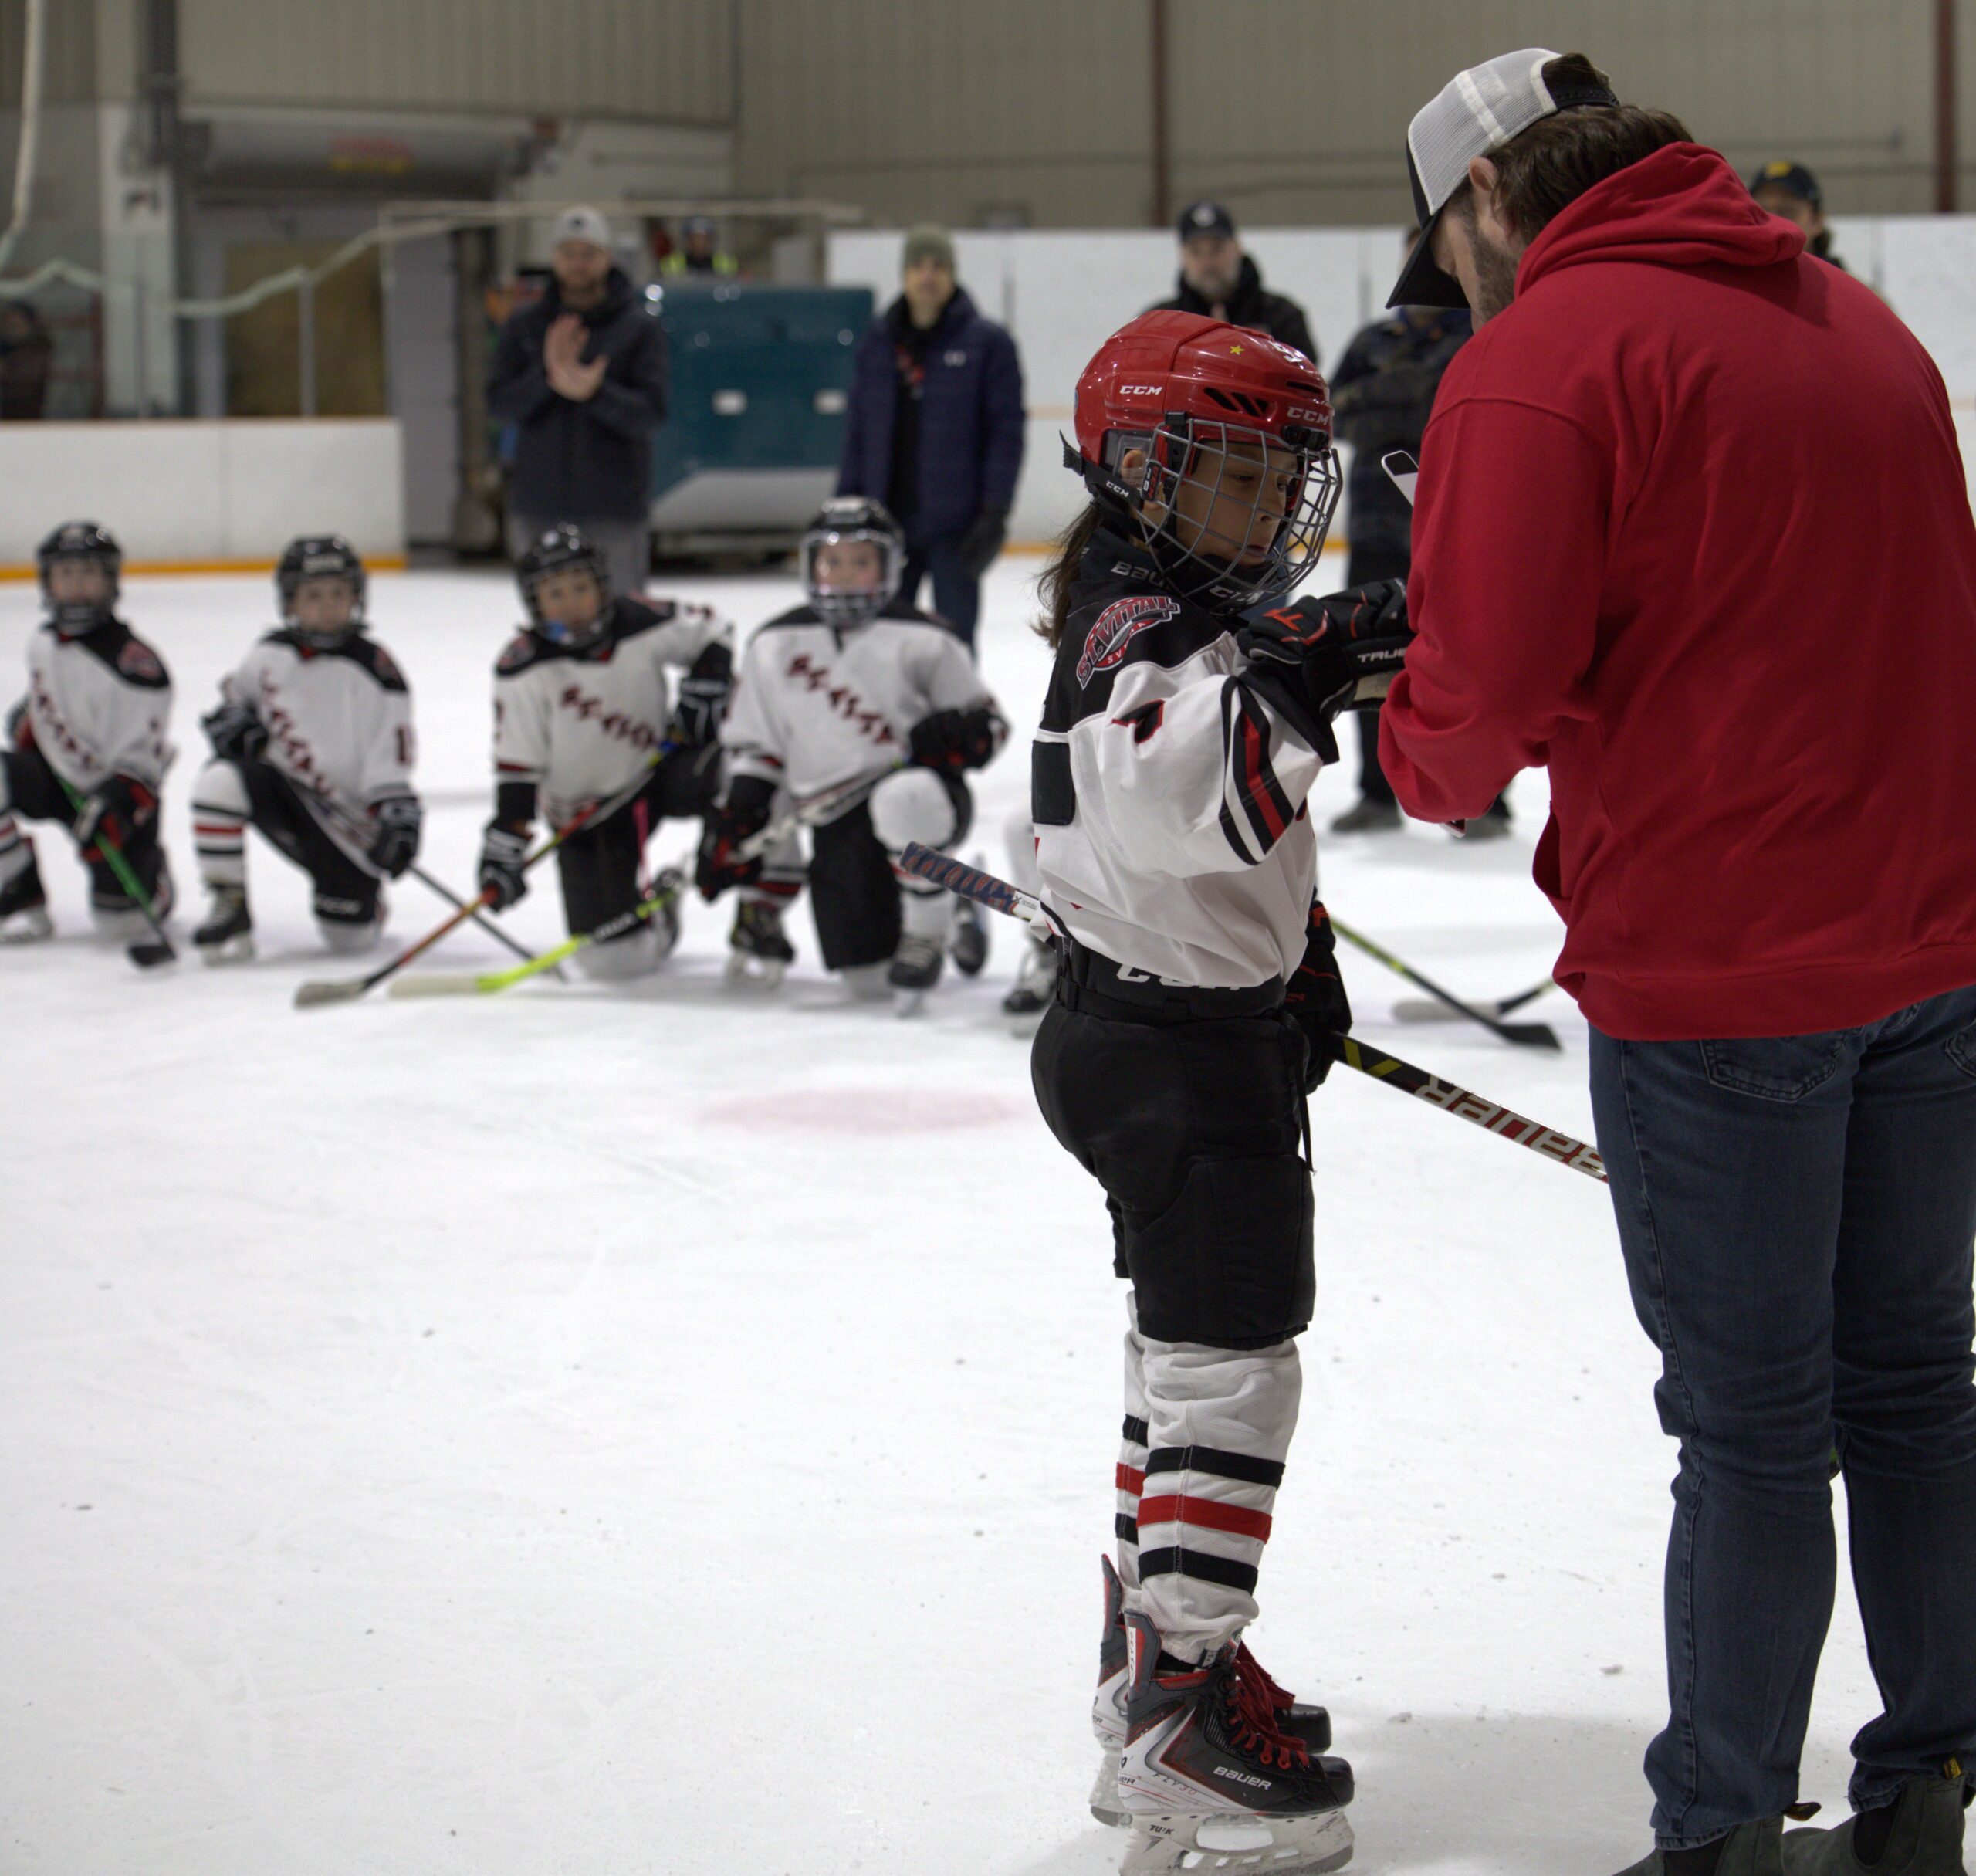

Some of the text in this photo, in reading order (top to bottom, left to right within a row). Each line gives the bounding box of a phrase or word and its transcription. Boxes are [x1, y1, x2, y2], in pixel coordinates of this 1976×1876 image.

[1119, 385, 1162, 395] CCM
[1287, 405, 1328, 425] CCM
[1105, 480, 1129, 498] CCM
[1097, 596, 1176, 647] VITAL
[1413, 1074, 1608, 1179] BAUER
[1213, 1766, 1272, 1790] BAUER
